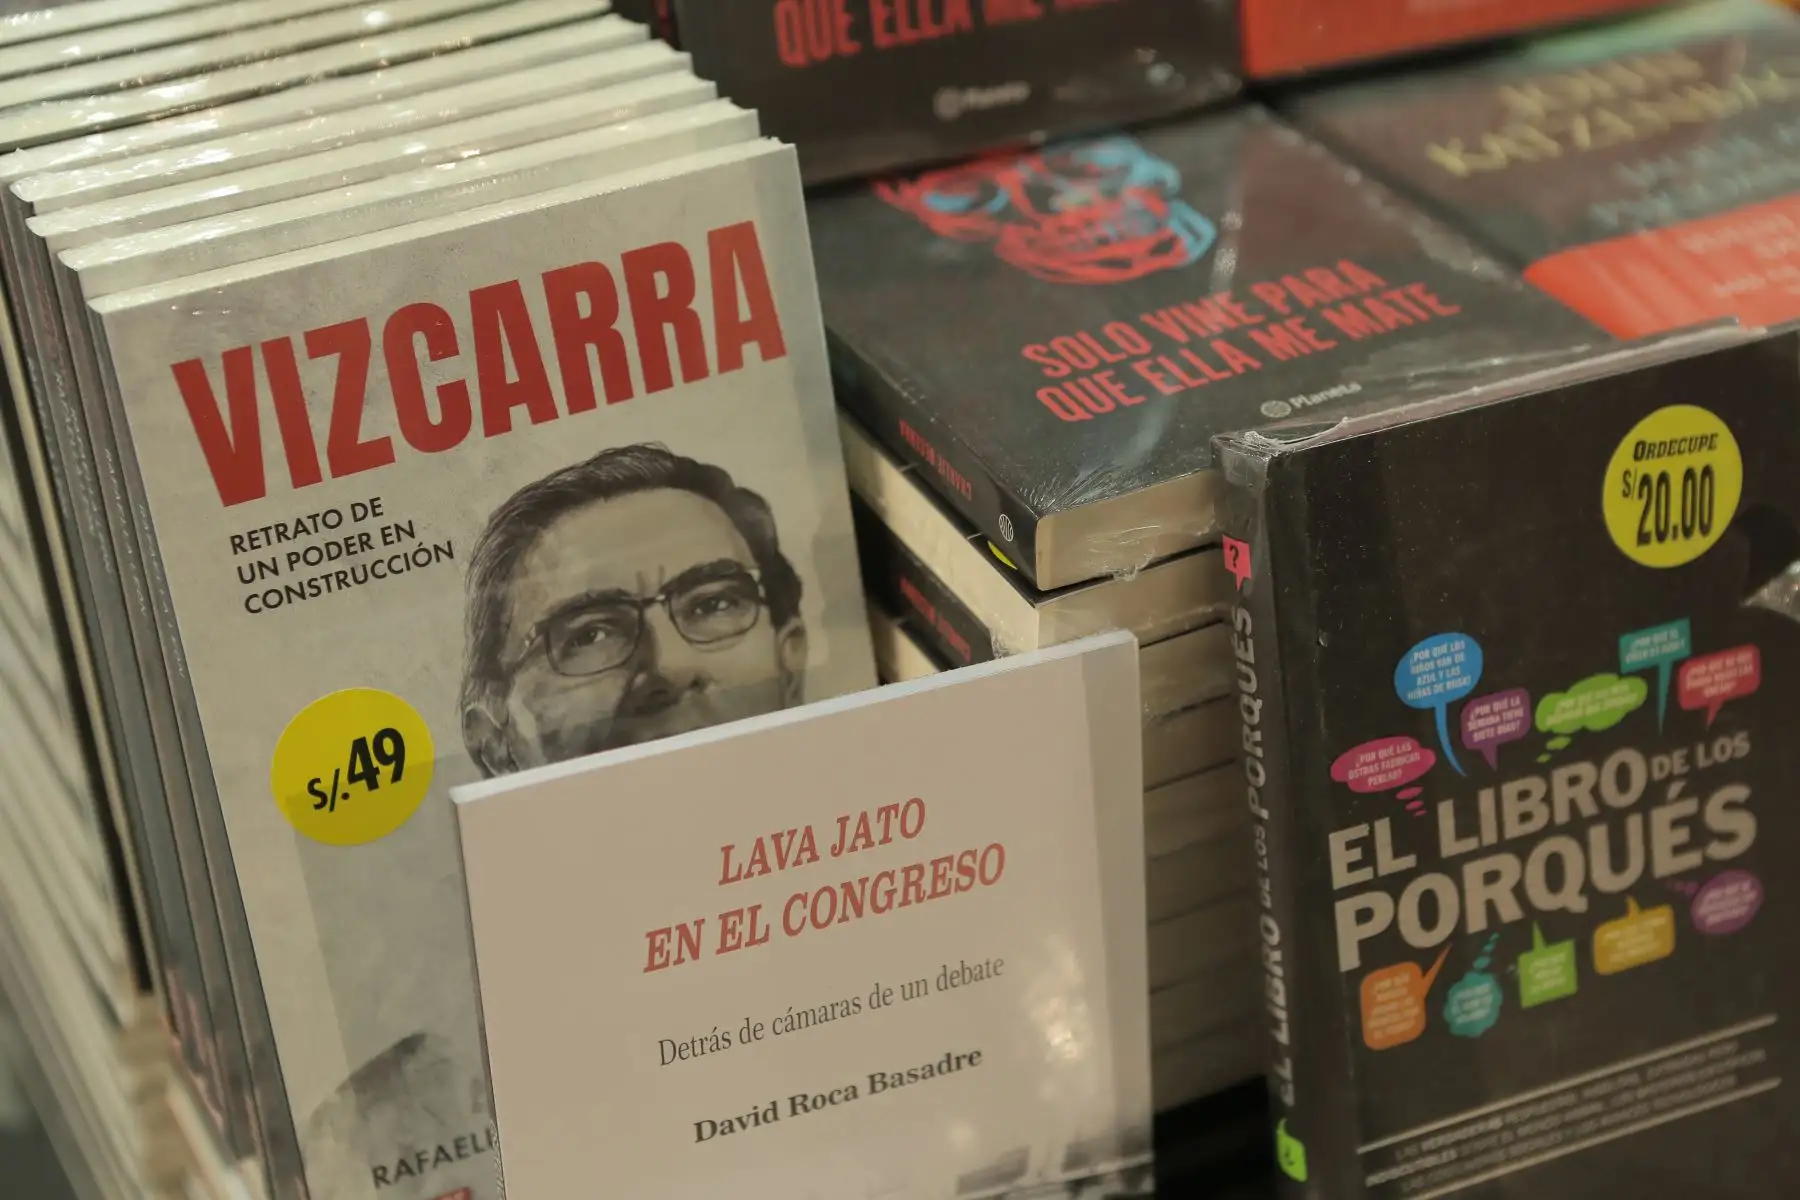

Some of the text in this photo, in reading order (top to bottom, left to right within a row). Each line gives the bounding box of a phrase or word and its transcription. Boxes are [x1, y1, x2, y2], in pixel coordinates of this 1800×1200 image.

[774, 0, 862, 67] QUE
[170, 220, 787, 507] VIZCARRA
[1021, 259, 1386, 378] SOLO VINE PARA
[1036, 282, 1461, 422] QUE ELLA ME MATE
[1289, 381, 1362, 408] Planeta
[229, 497, 384, 555] RETRATO DE
[237, 519, 416, 586] UN PODER EN
[243, 540, 455, 615] CONSTRUCCIÓN
[718, 797, 926, 885] LAVA JATO
[1329, 732, 1750, 890] EL LIBRO DE LOS
[643, 842, 1005, 973] EN EL CONGRESO
[1334, 781, 1757, 972] PORQUÉS
[658, 954, 1005, 1067] Detrás de cámaras de un debate
[693, 1047, 983, 1144] David Roca Basadre
